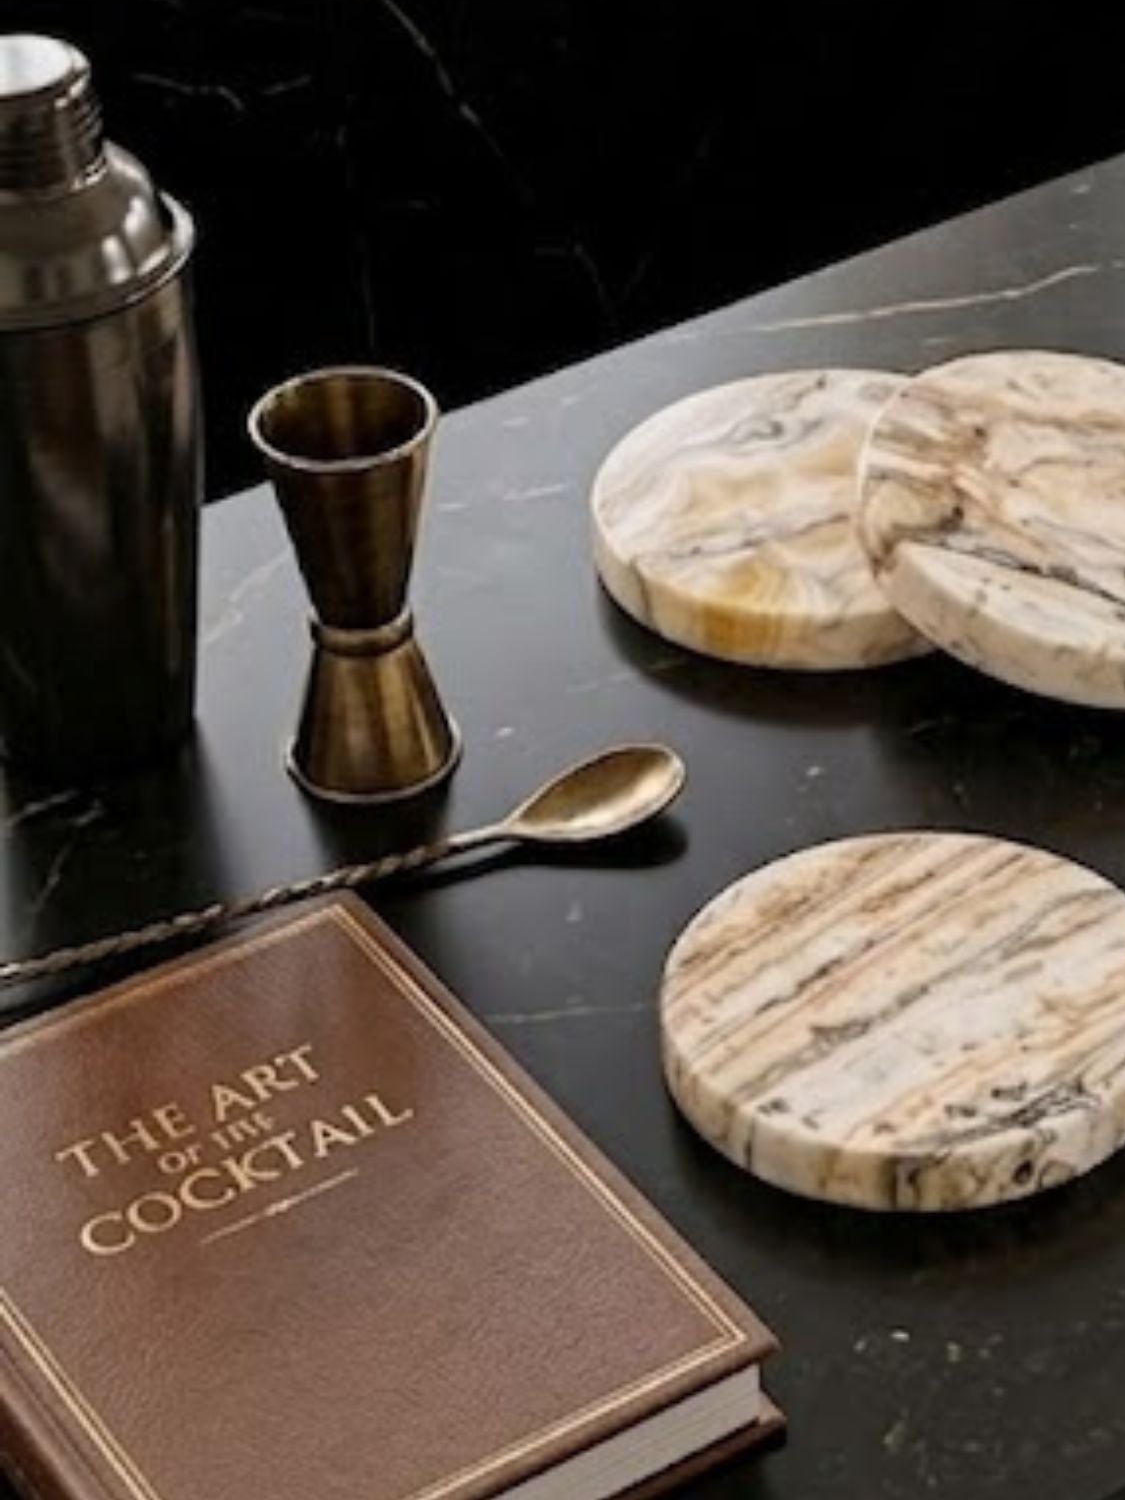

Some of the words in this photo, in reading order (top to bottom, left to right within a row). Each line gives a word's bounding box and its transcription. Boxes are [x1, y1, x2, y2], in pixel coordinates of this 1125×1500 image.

[55, 1102, 196, 1178] THE
[211, 1045, 319, 1122] ART
[80, 1094, 414, 1256] COCKTAIL
[158, 1144, 202, 1174] OF
[211, 1111, 275, 1150] THE
